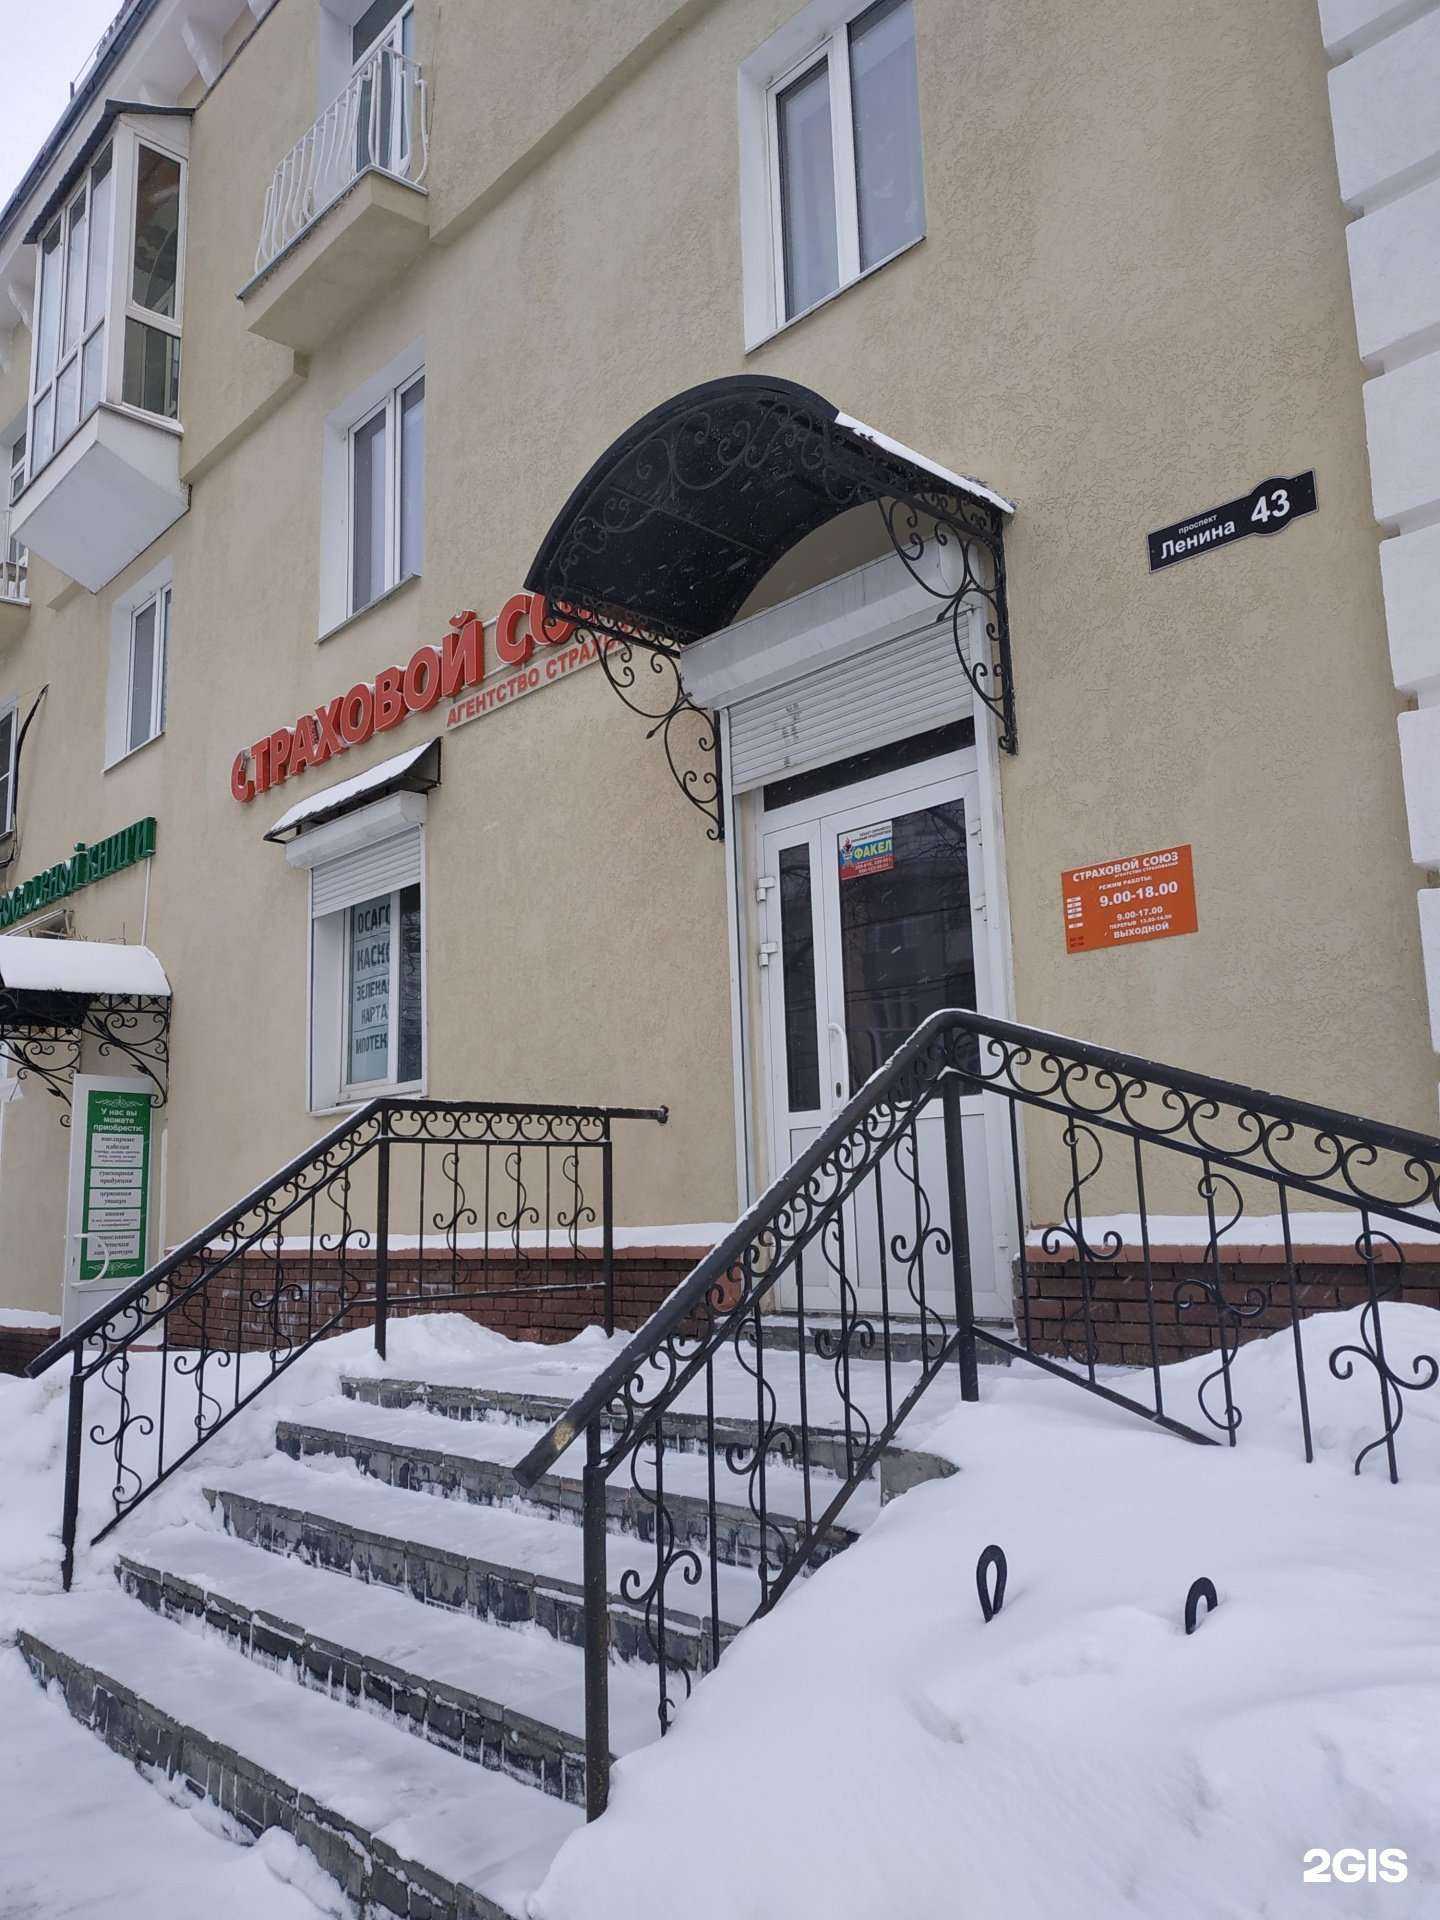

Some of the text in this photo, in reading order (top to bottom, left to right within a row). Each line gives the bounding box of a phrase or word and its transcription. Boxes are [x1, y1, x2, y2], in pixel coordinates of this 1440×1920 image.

[1160, 488, 1291, 560] Ленина 43
[1178, 514, 1218, 535] проспект
[231, 591, 600, 802] СТРАХОВОЙ СО
[447, 668, 540, 727] АГЕНТСТВО
[854, 838, 893, 860] ФАКЕЛ
[1072, 851, 1179, 882] СТРАХОВОЙ СОЮЗ
[1098, 881, 1122, 891] РЕЖИМ
[1099, 881, 1179, 908] 9.00-18.00
[1116, 905, 1164, 921] 9.00-17.00
[1113, 921, 1170, 939] ВЫХОДНОЙ
[356, 979, 389, 1002] ЗЕЛЕНА
[361, 1003, 389, 1025] КАРТА
[100, 1107, 107, 1115] У
